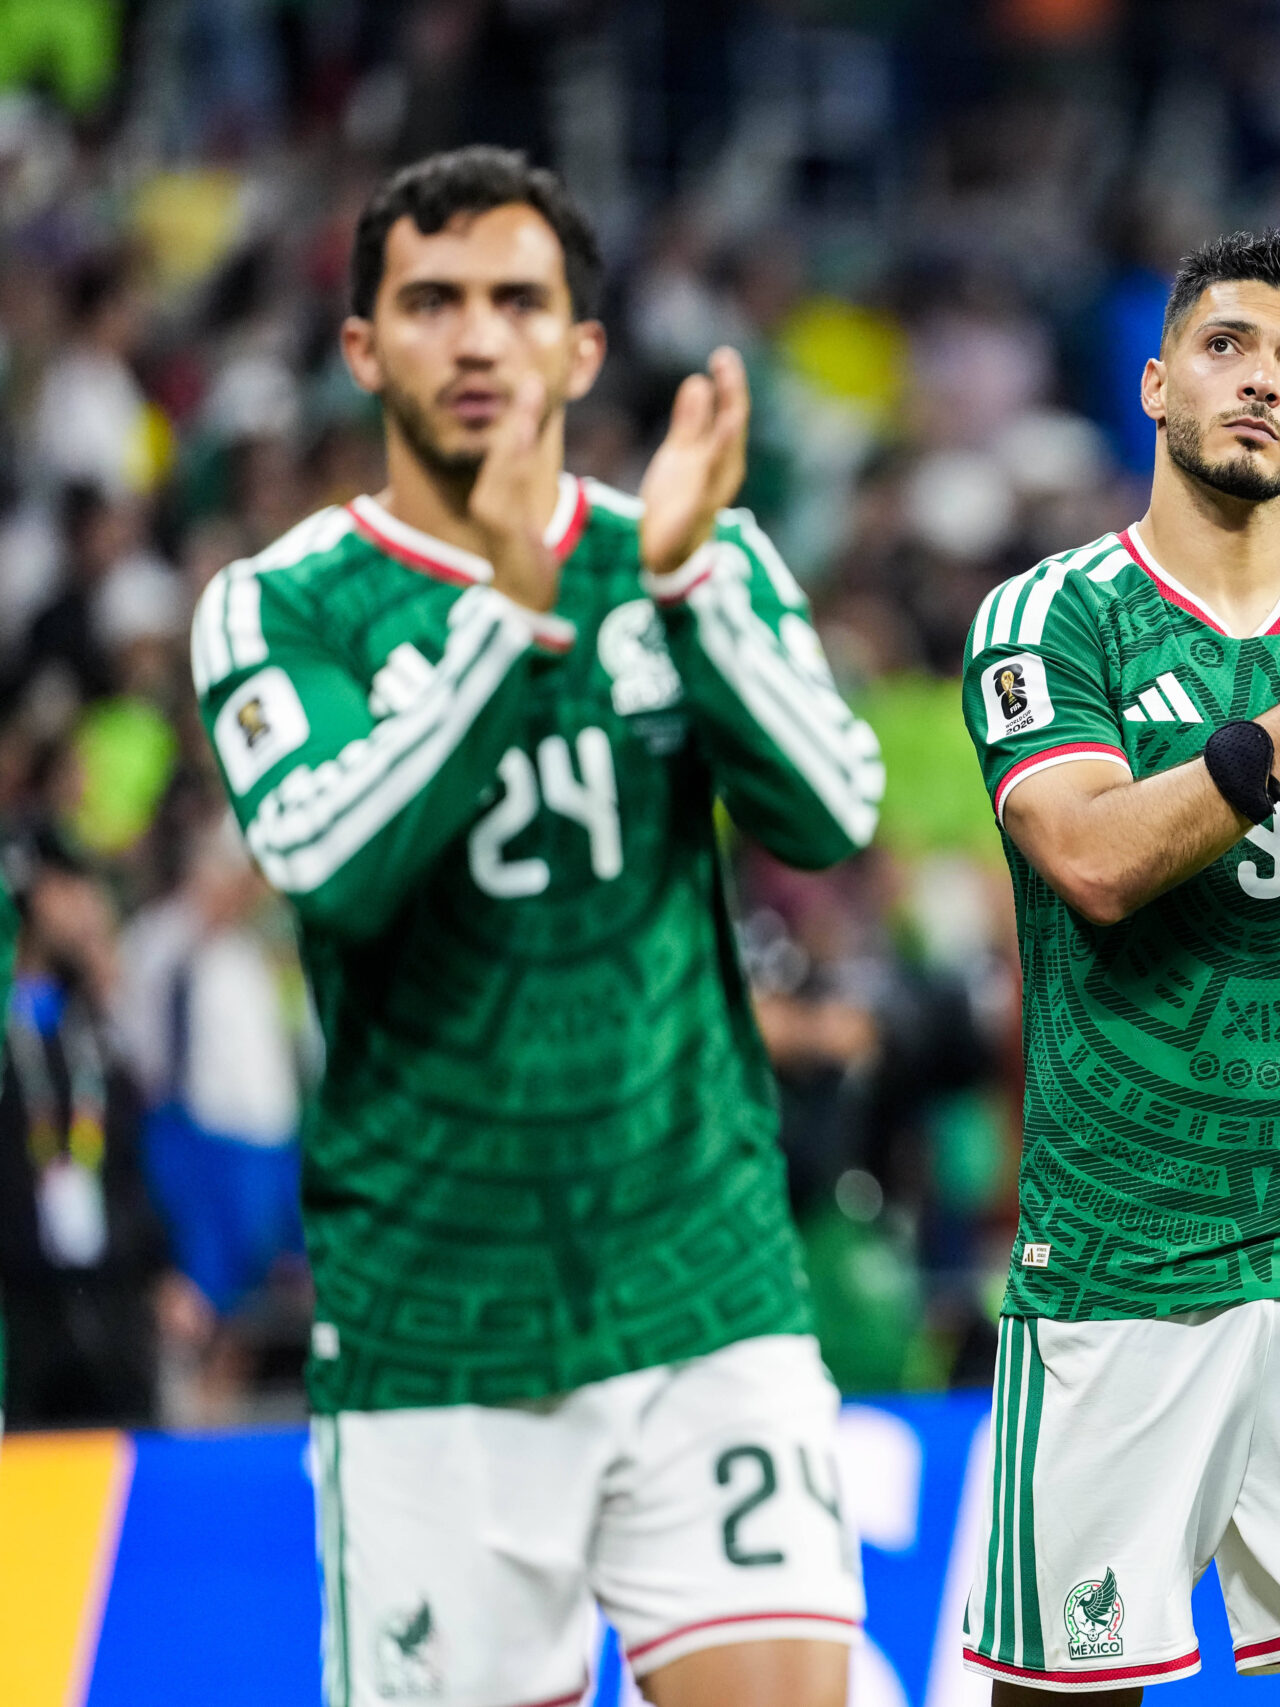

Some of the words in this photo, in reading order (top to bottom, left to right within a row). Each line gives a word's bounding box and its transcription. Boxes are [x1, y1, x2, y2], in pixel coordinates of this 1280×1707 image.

[1010, 702, 1022, 714] FIFA
[1005, 715, 1022, 729] WORLD
[1022, 709, 1032, 720] CUP
[1006, 716, 1034, 736] 2026
[467, 725, 624, 899] 24
[1070, 1641, 1120, 1656] MÉXICO
